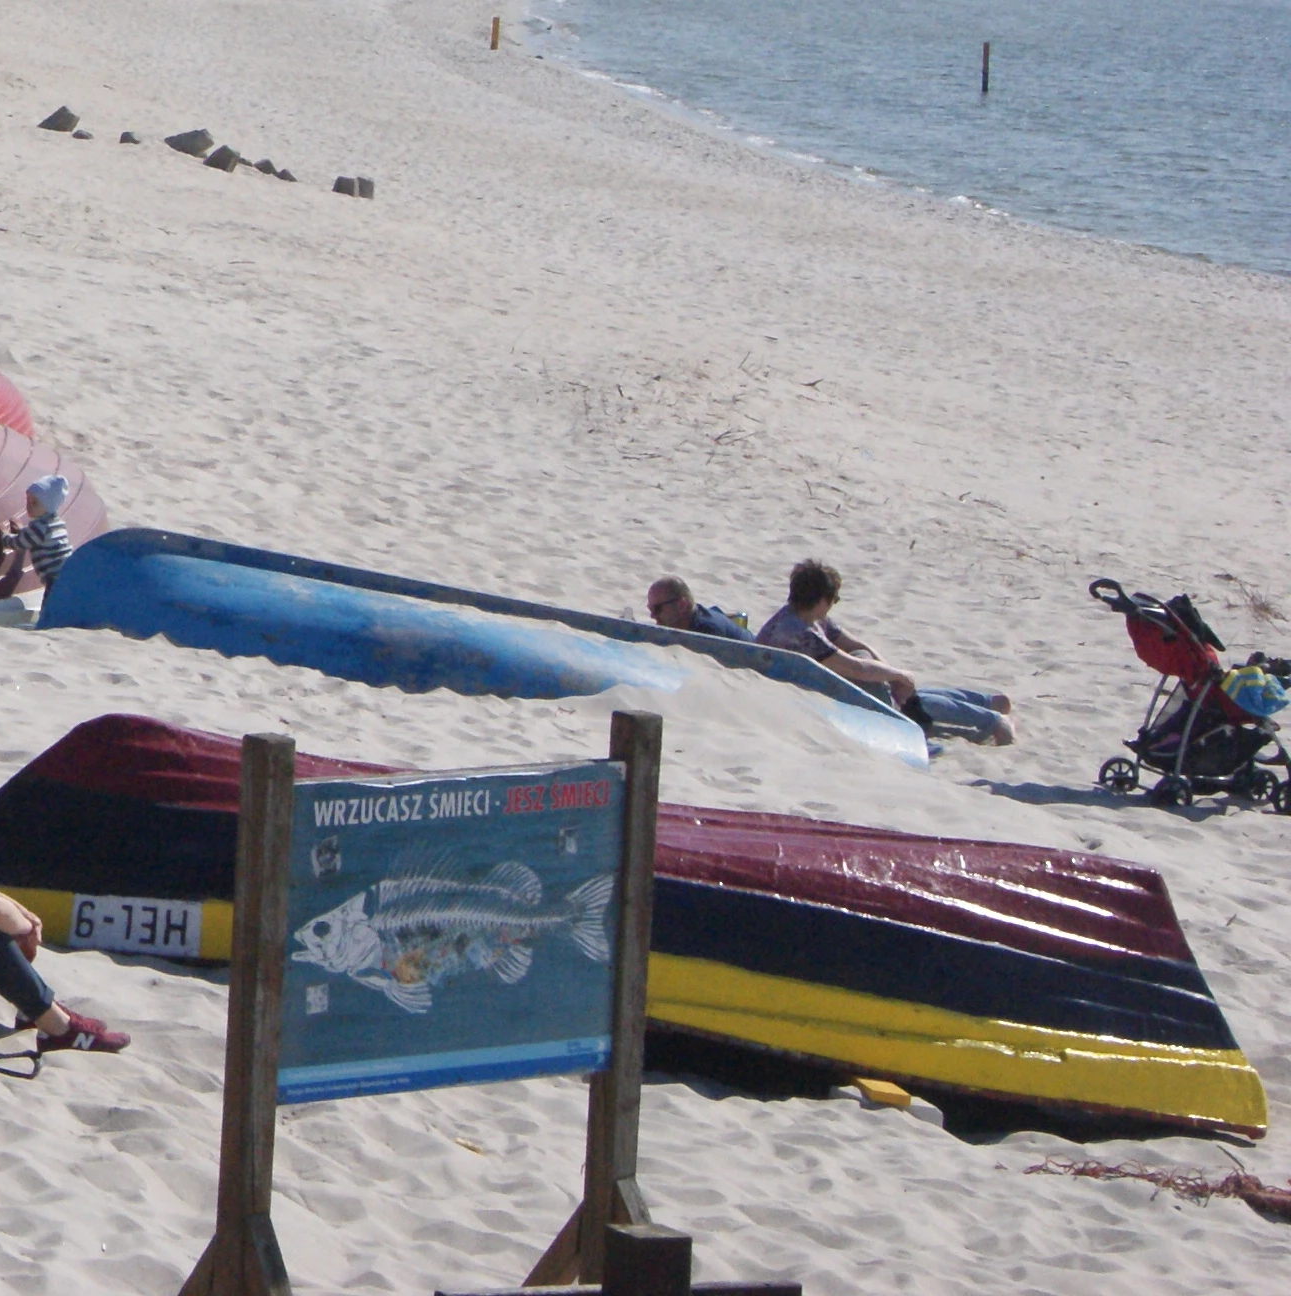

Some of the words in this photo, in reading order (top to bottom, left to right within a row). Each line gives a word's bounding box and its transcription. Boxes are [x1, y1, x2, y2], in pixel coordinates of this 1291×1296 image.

[313, 795, 424, 827] WRZUCASZ
[429, 787, 490, 820] ŚMIECI
[503, 786, 545, 815] JESZ
[550, 779, 611, 811] ŚMIECI
